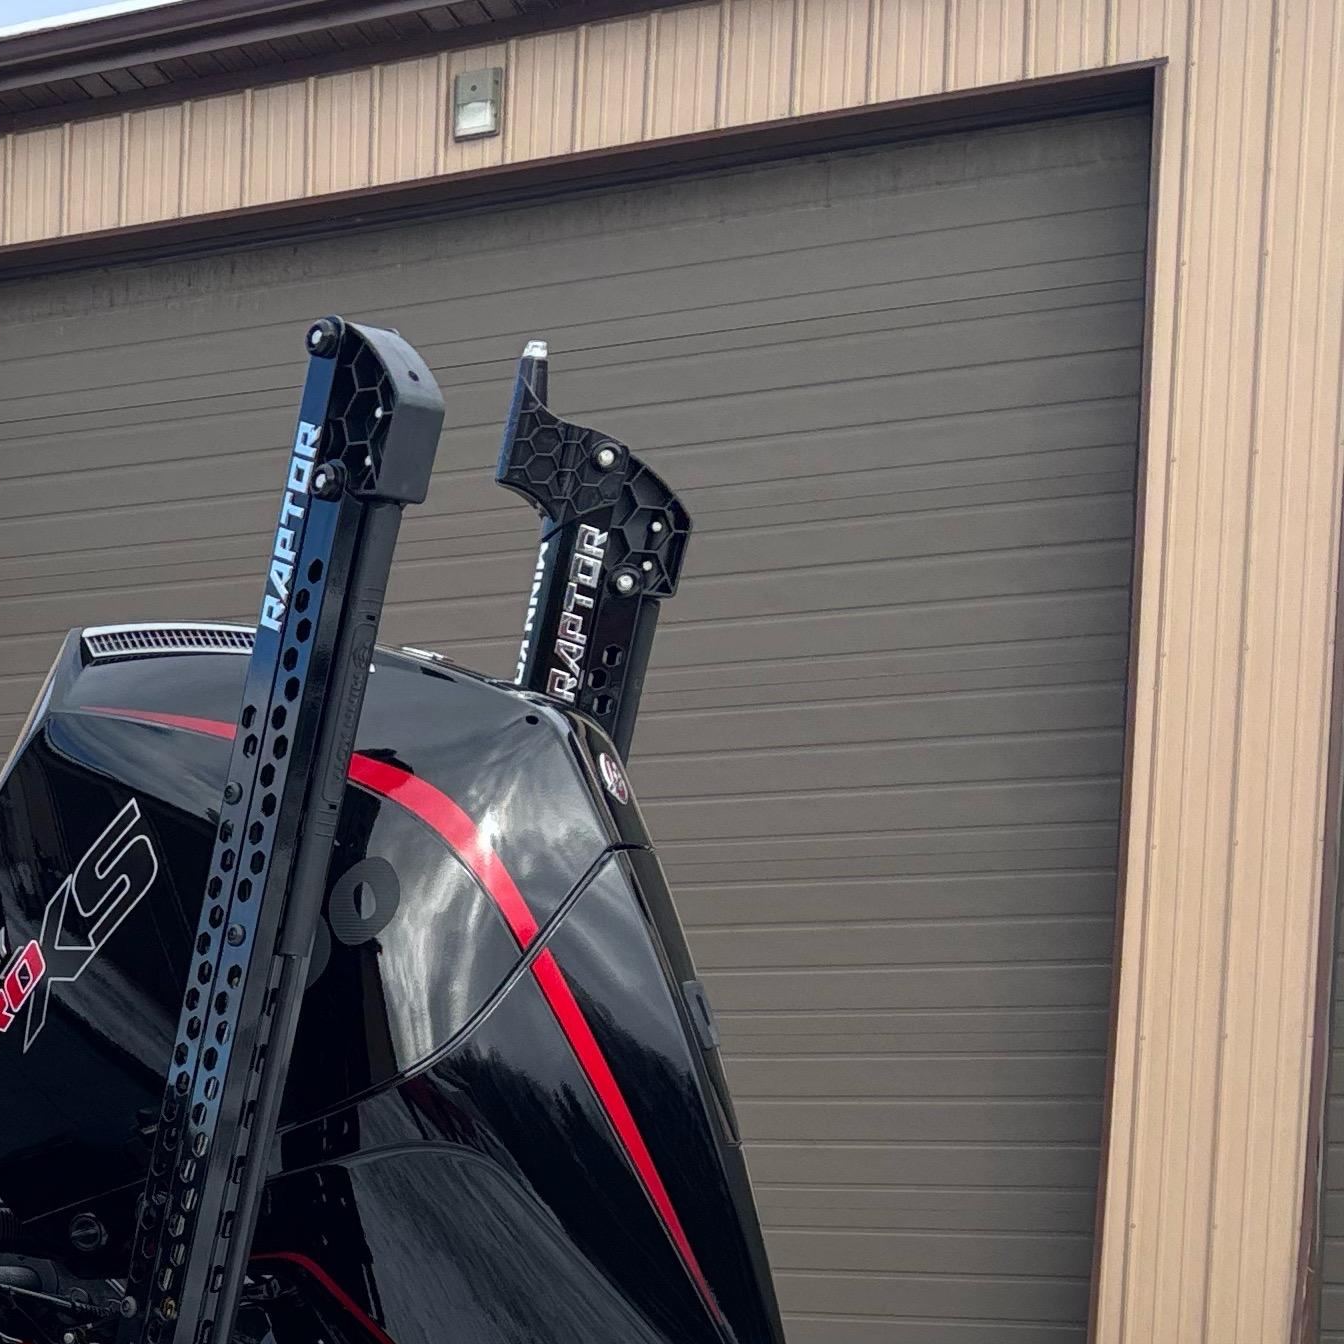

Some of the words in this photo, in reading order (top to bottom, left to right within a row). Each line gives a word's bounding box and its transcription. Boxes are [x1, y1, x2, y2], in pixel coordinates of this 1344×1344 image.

[261, 420, 322, 633] RAPTOR
[546, 523, 609, 703] RAPTOR
[0, 797, 158, 1054] XS
